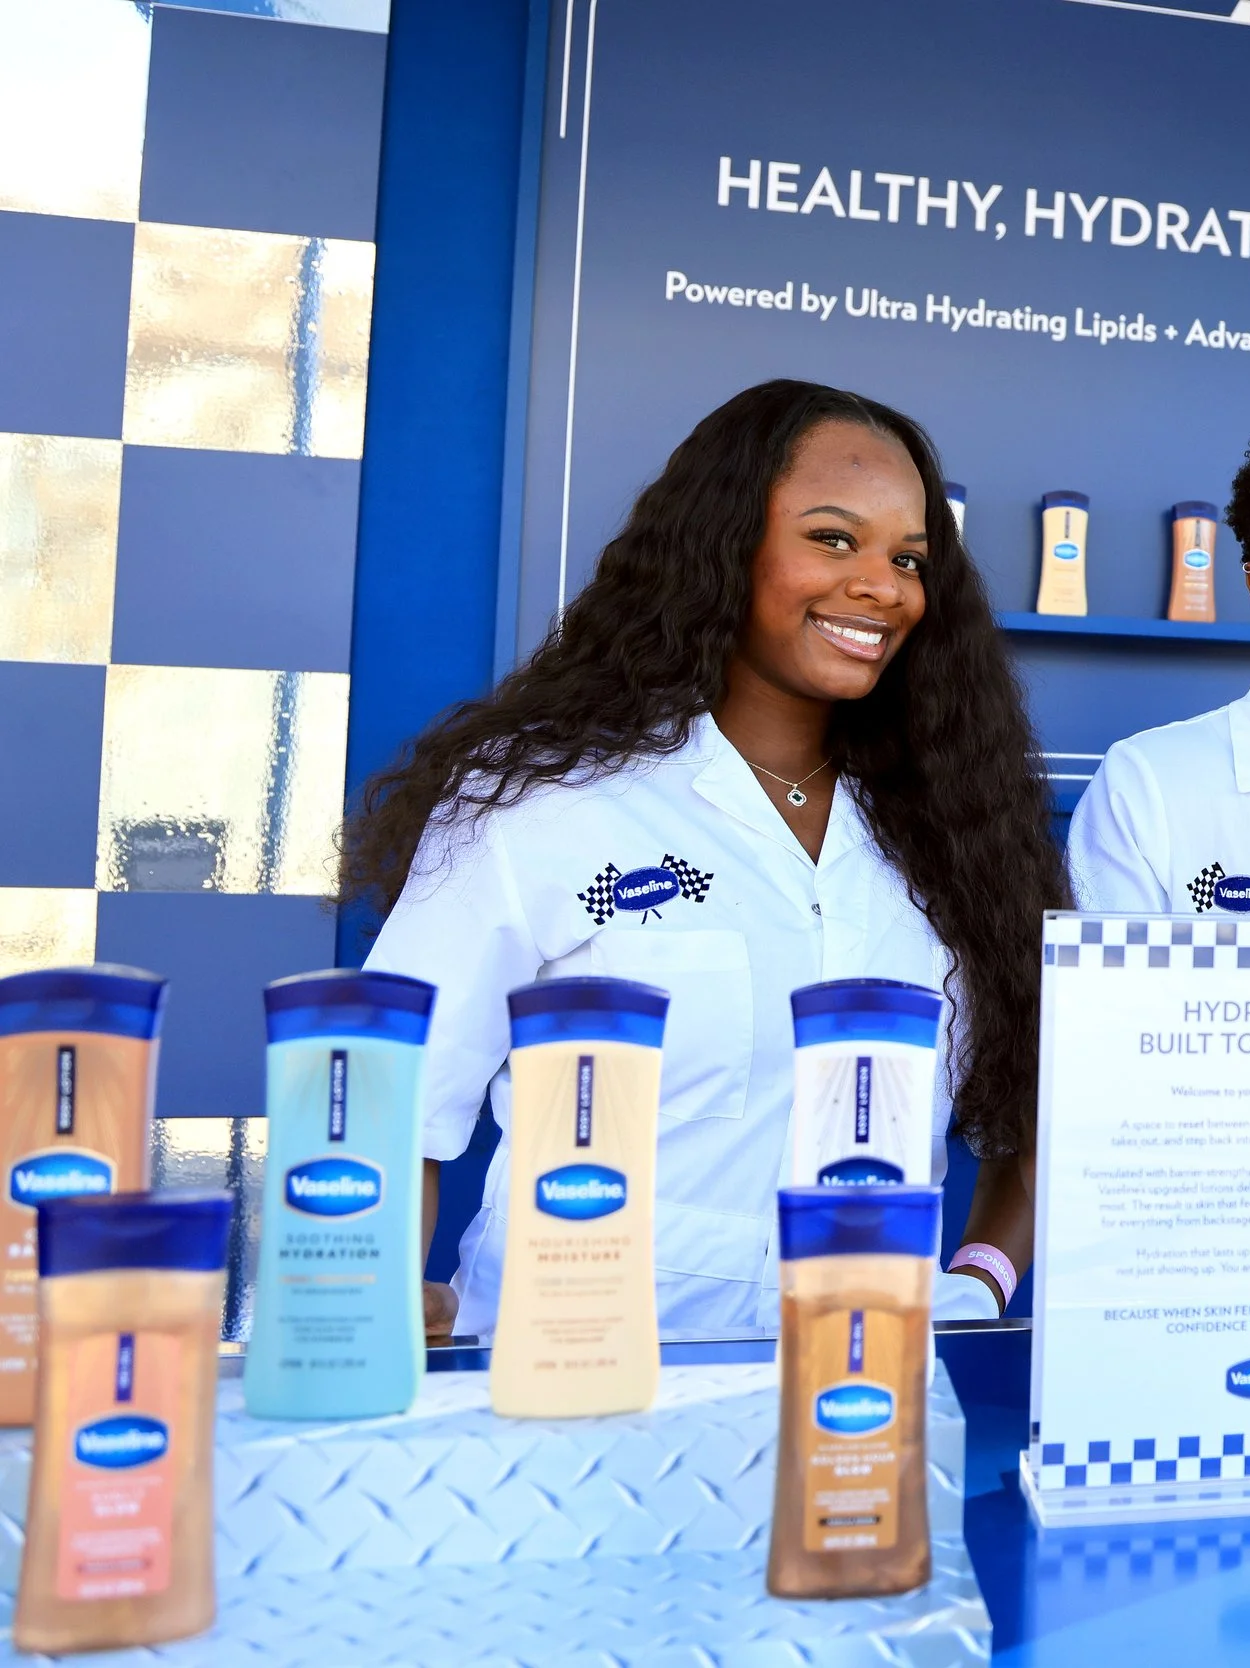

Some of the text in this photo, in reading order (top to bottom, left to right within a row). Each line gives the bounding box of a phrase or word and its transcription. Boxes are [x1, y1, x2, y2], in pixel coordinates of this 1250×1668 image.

[716, 155, 1006, 240] HEALTHY,
[664, 270, 793, 312] Powered
[800, 282, 837, 321] by
[844, 286, 919, 324] Ultra
[925, 296, 1067, 342] Hydrating
[1074, 307, 1157, 347] Lipids
[1140, 1032, 1213, 1054] BUILT
[279, 1248, 380, 1259] HYDRATION
[537, 1252, 621, 1263] MOISTURE
[1103, 1308, 1160, 1321] BECAUSE
[1162, 1307, 1201, 1319] WHEN
[1204, 1306, 1232, 1318] SKIN
[1166, 1320, 1248, 1334] CONFIDENCE
